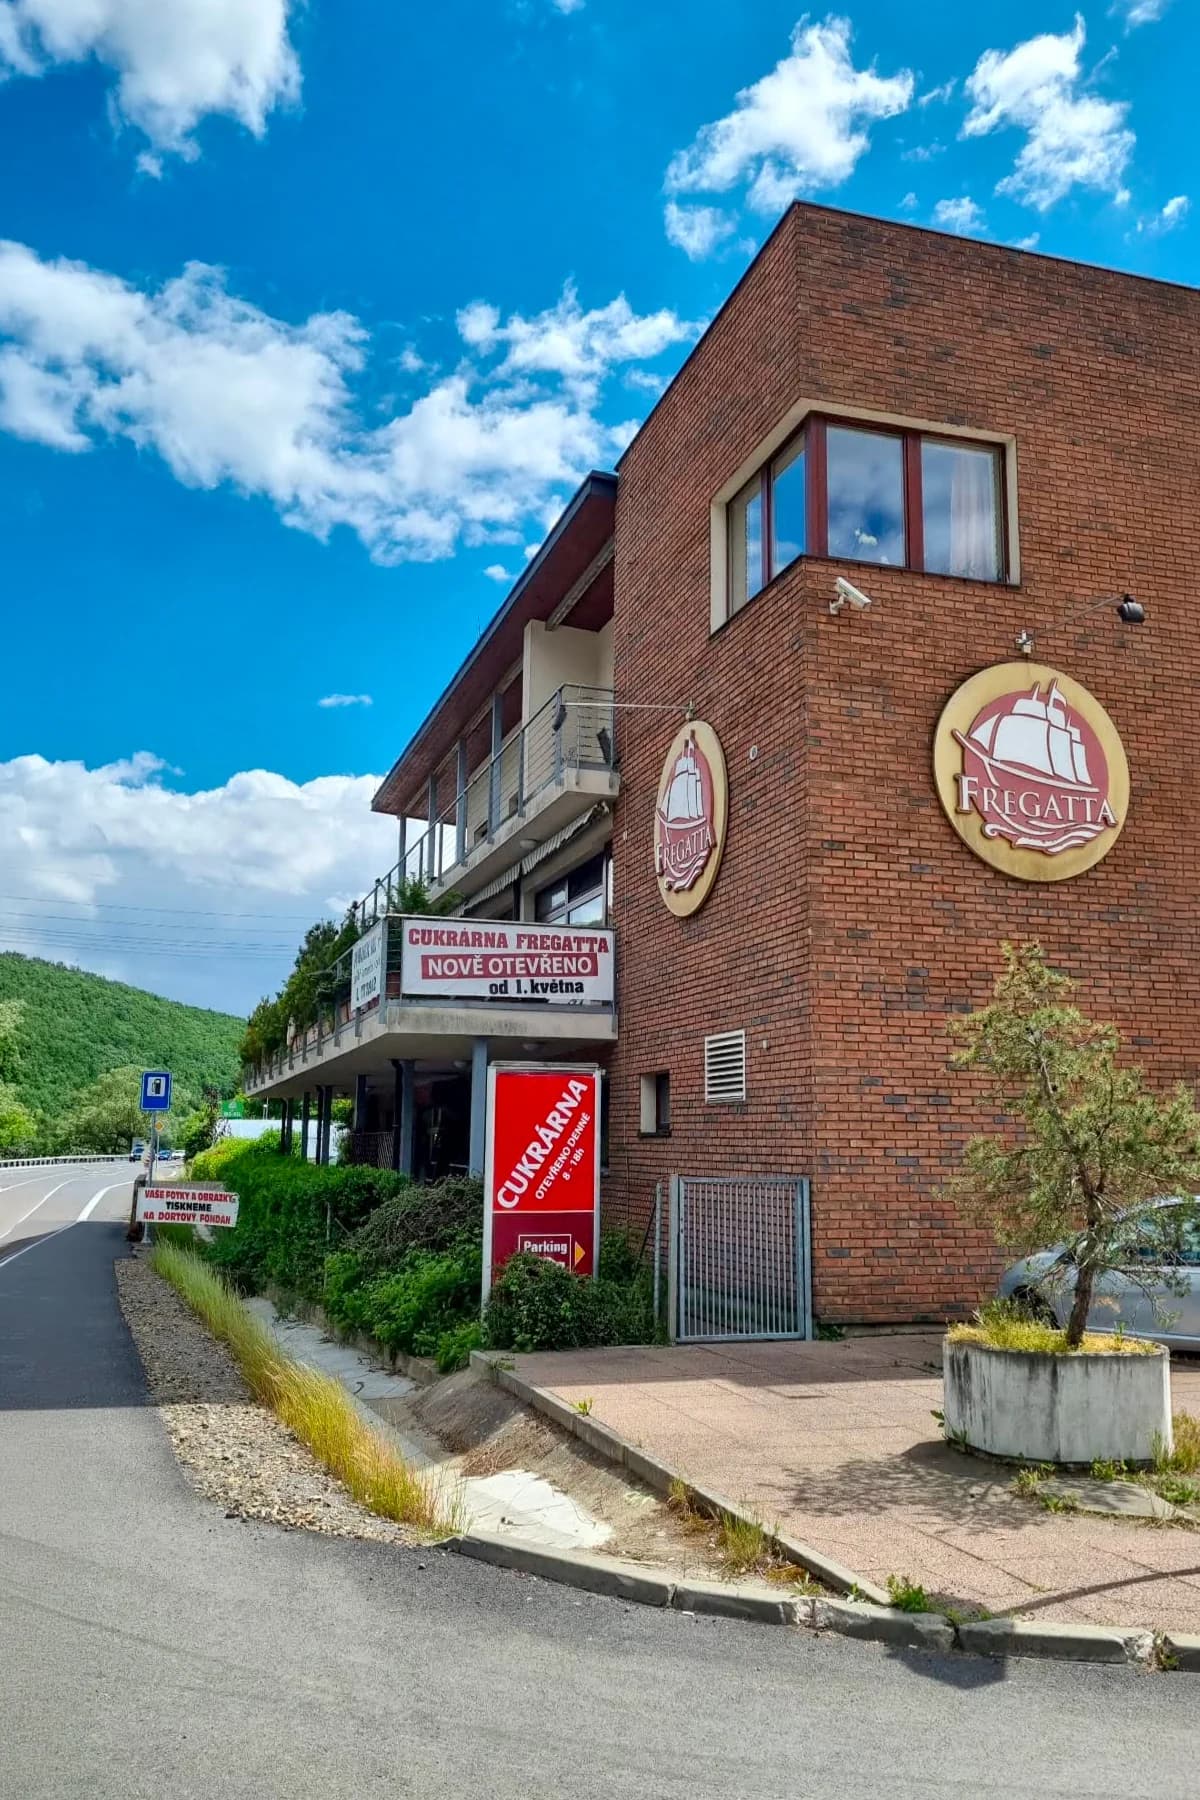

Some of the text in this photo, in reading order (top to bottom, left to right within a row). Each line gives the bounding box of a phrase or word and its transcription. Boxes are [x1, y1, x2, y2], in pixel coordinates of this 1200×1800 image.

[956, 775, 1118, 826] FREGATTA
[656, 828, 714, 876] FREGATTA
[408, 928, 609, 953] CUKRÁRNA FREGATTA
[428, 953, 592, 976] NOVĚ OTEVŘENO
[489, 980, 509, 995] od
[497, 1079, 588, 1209] CUKRÁRNA
[535, 1146, 571, 1200] OTEVŘENO
[562, 1171, 571, 1181] 8
[570, 1147, 585, 1167] 18h
[166, 1190, 190, 1201] FOTKY
[191, 1191, 197, 1201] A
[166, 1201, 212, 1212] TISKNEME
[144, 1211, 154, 1220] NA
[524, 1240, 568, 1255] Parking
